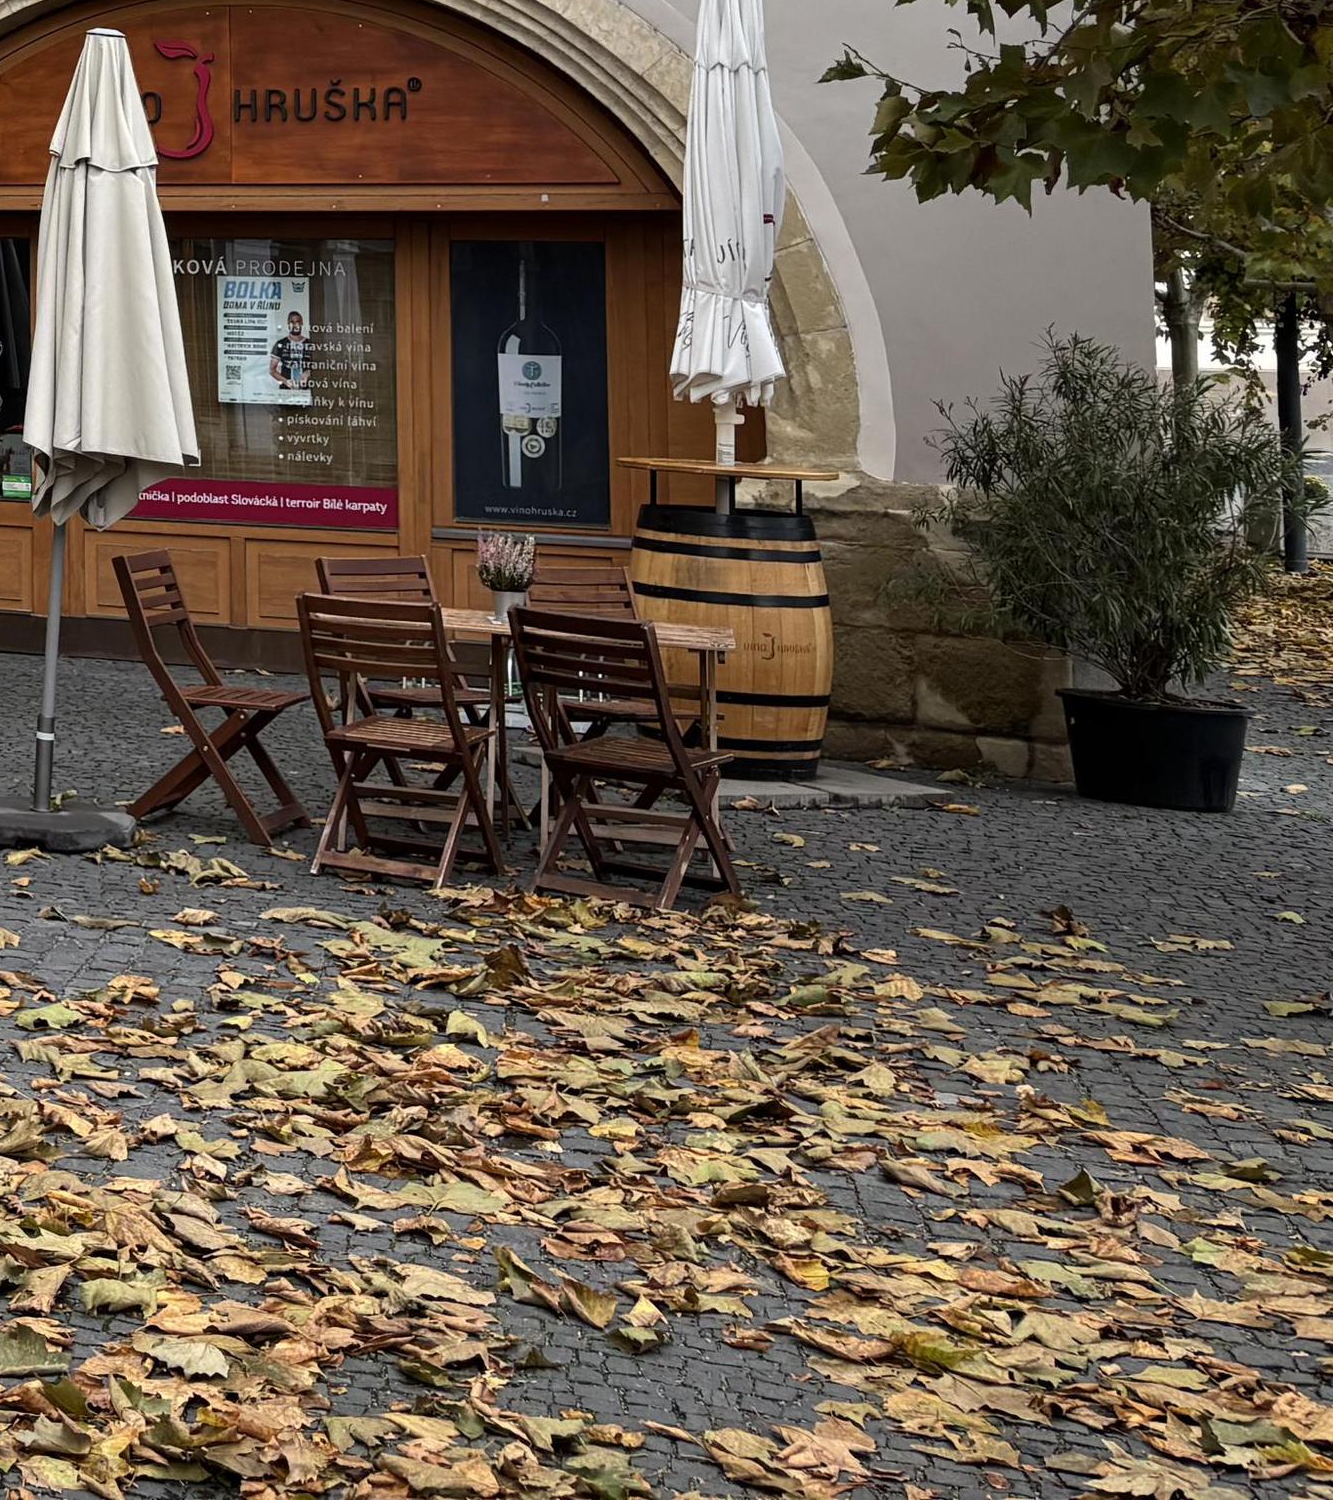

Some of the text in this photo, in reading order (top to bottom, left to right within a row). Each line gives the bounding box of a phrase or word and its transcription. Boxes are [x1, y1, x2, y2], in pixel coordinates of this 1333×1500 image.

[173, 256, 346, 277] KOVÁ PRODEJNA
[224, 281, 282, 300] BOLKA
[336, 322, 374, 334] balení
[332, 379, 357, 389] vína
[338, 397, 345, 407] k
[349, 398, 374, 409] vínu
[287, 415, 343, 427] pískování
[287, 432, 329, 446] vývrtky
[287, 451, 333, 465] nálevky
[177, 492, 231, 506] podoblast
[231, 493, 279, 508] Slovácká
[285, 497, 320, 509] terroir
[345, 499, 388, 514] karpaty
[484, 504, 577, 518] www.vinohruska.cz
